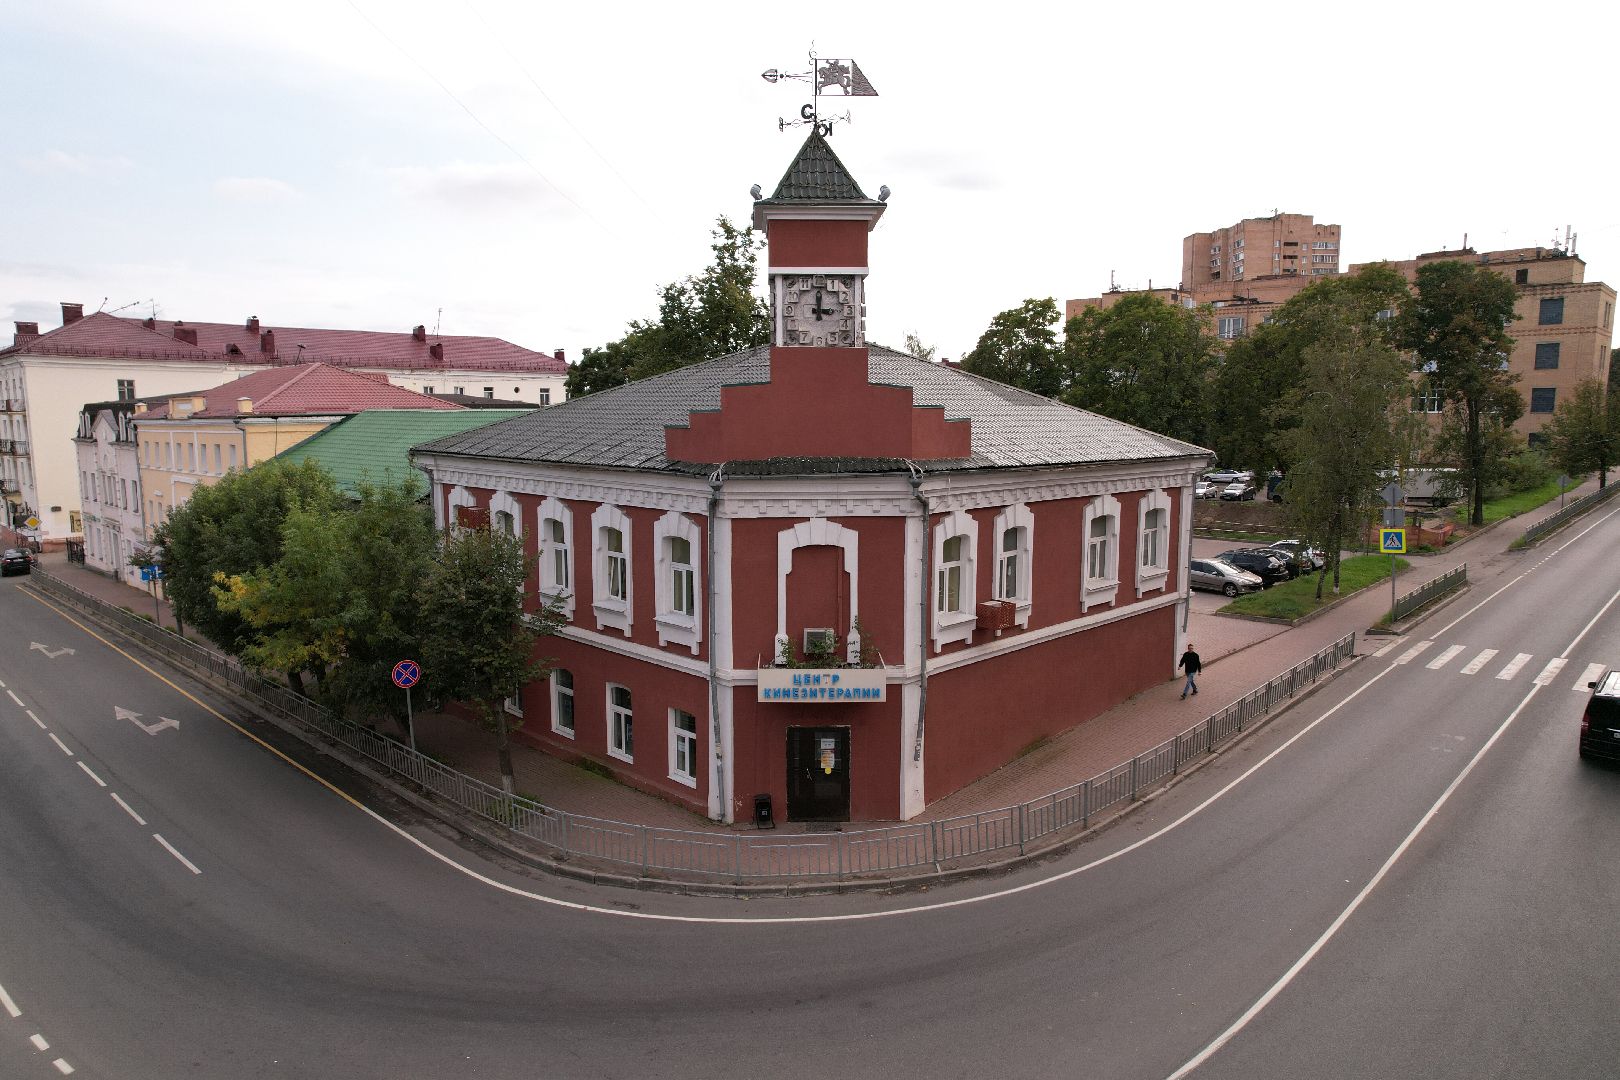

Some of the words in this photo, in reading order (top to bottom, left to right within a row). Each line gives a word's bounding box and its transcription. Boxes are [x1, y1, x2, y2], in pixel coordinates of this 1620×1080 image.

[801, 279, 809, 289] 11
[841, 291, 848, 302] 2
[785, 305, 793, 315] 9
[846, 305, 853, 315] 3
[841, 319, 848, 330] 4
[801, 332, 808, 342] 7
[816, 336, 823, 346] 6
[829, 332, 837, 342] 5
[793, 674, 840, 687] ЦЕНТР
[764, 687, 880, 699] КИНЕЗИТЕРАПИИ
